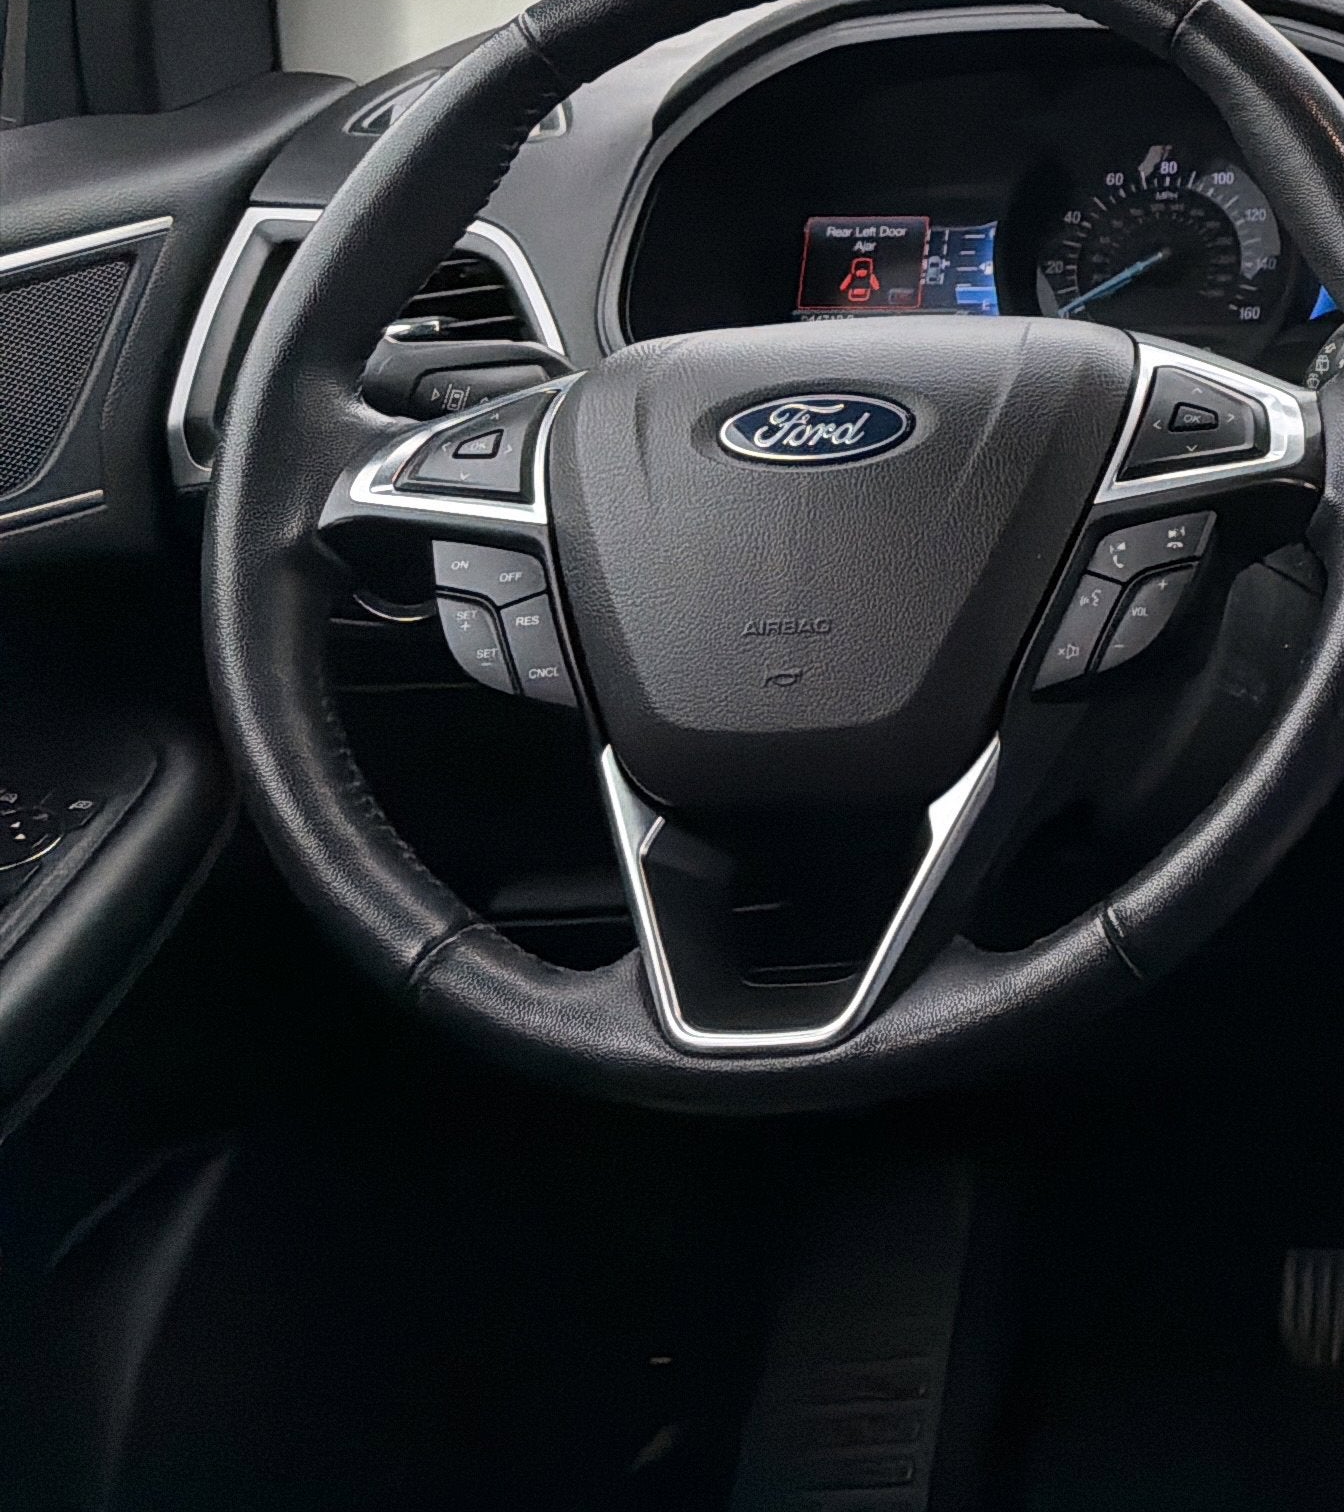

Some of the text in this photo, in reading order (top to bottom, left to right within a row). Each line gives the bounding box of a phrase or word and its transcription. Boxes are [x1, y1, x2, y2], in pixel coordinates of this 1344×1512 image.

[1160, 161, 1177, 174] 80
[1106, 172, 1124, 185] 60
[1213, 172, 1234, 184] 100
[1064, 210, 1081, 223] 40
[1246, 208, 1266, 221] 120
[826, 226, 907, 237] Rear Left Door
[854, 241, 876, 253] Ajar
[1046, 261, 1063, 274] 20
[1256, 257, 1277, 270] 140
[1239, 307, 1260, 320] 160
[1183, 413, 1202, 424] OK
[754, 402, 870, 448] Ford
[470, 440, 487, 451] OK
[451, 560, 470, 570] ON
[499, 571, 522, 583] OFF
[456, 610, 477, 621] SET
[1131, 606, 1148, 617] VOL
[515, 614, 539, 627] RES
[743, 619, 832, 636] AIRBAG
[476, 648, 498, 659] SET
[528, 667, 559, 679] CNCL
